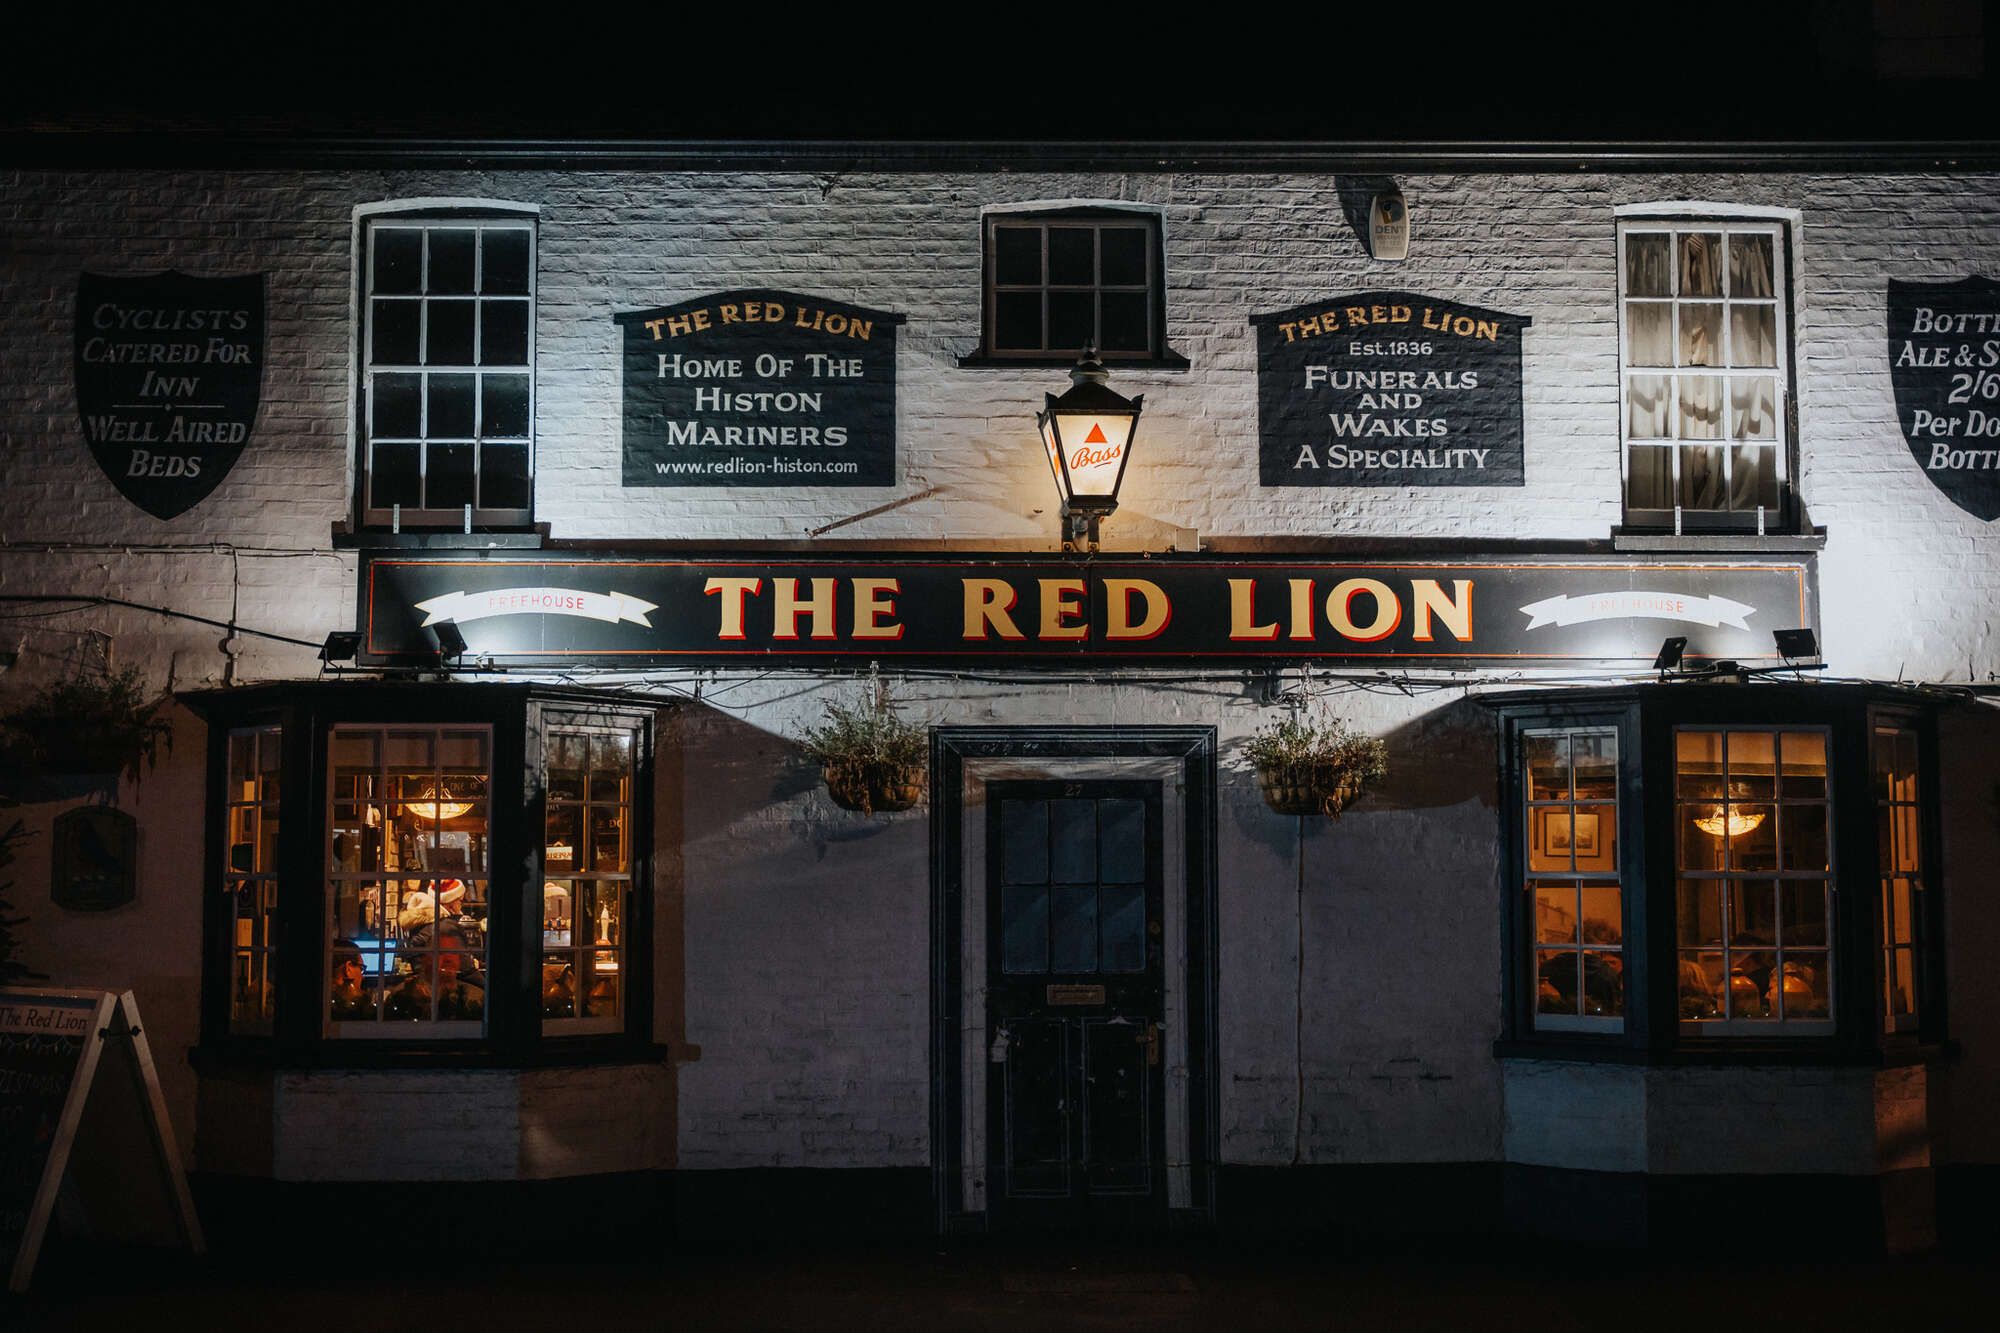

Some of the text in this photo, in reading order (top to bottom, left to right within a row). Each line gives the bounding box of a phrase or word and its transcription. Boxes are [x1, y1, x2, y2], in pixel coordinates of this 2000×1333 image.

[92, 303, 249, 331] CYCLISTS
[645, 302, 873, 341] THE RED LION
[1278, 305, 1500, 343] THE RED LION
[82, 336, 252, 364] CATERED FOR
[1349, 341, 1433, 356] Est.1836
[1896, 340, 1950, 367] ALE
[1954, 344, 1976, 367] &
[657, 353, 865, 378] HOME OF THE
[1304, 365, 1478, 390] FUNERALS
[139, 370, 201, 398] INN
[1948, 370, 2000, 404] 2/6
[695, 387, 823, 412] HISTON
[1357, 393, 1423, 410] AND
[87, 415, 246, 444] WELL AIRED
[666, 421, 848, 447] MARINERS
[1328, 413, 1448, 438] WAKES
[1911, 409, 1962, 437] Per
[126, 448, 202, 478] BEDS
[655, 457, 858, 475] www.redlion-histon.com
[1070, 443, 1121, 470] Bass
[1293, 444, 1491, 469] A SPECIALITY
[488, 594, 585, 610] FREEHOUSE
[703, 577, 1474, 642] THE RED LION
[0, 1007, 87, 1030] The Red Lion
